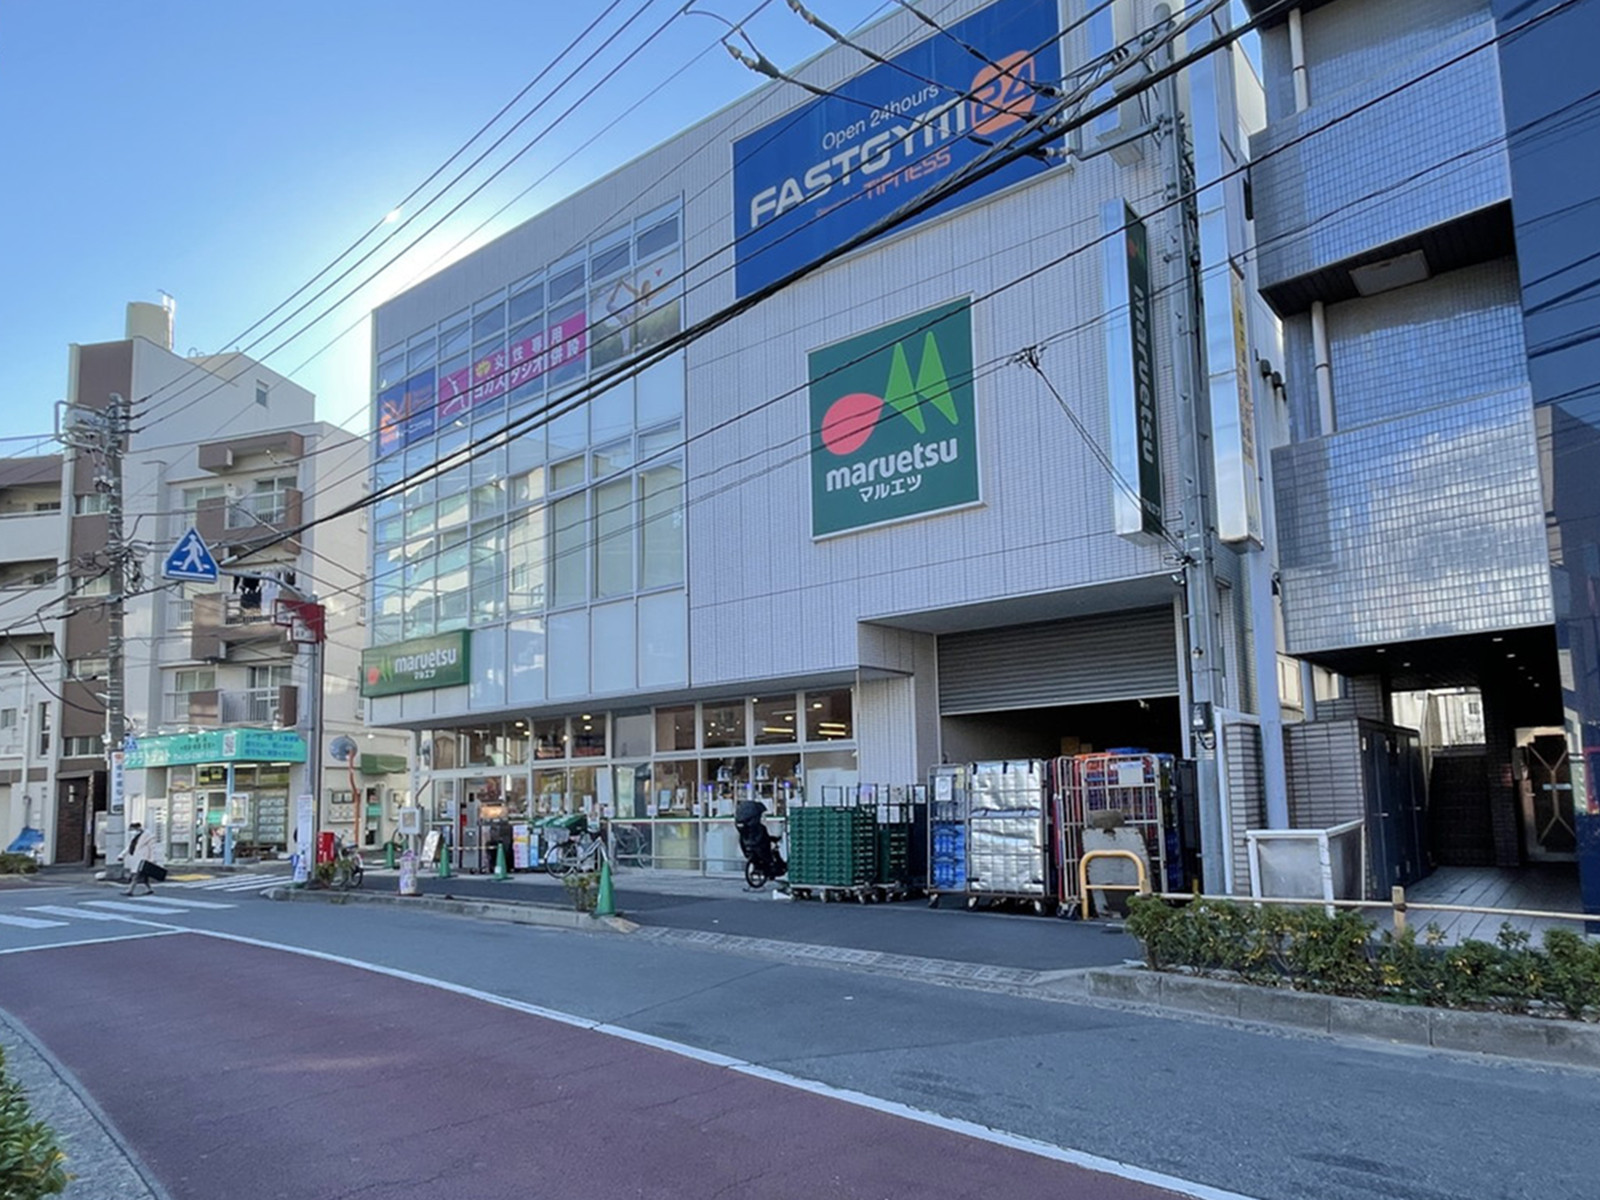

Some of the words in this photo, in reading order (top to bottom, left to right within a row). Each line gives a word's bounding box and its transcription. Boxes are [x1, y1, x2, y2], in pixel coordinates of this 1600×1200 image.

[822, 120, 865, 150] Open
[870, 85, 940, 128] 24hours
[1133, 284, 1154, 464] maruetsu
[826, 438, 958, 492] maruetsu
[859, 474, 922, 502] マルエツ
[395, 648, 457, 673] maruetsu
